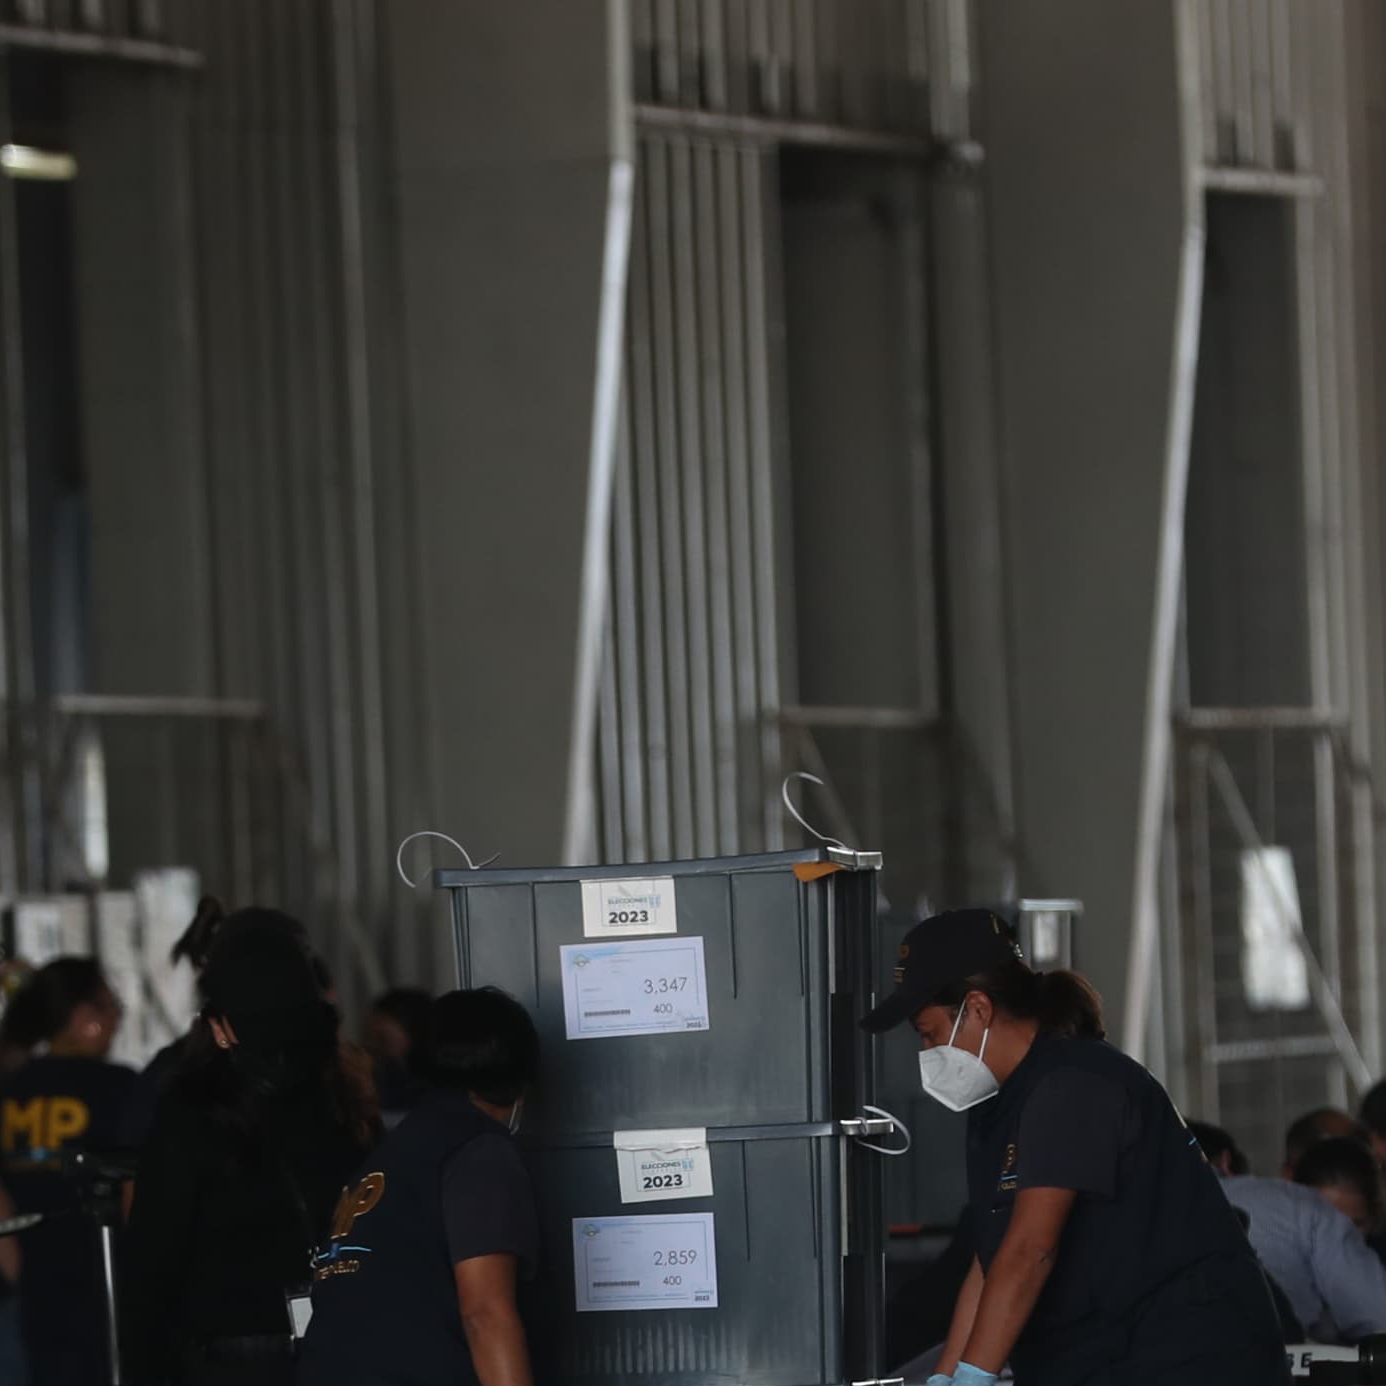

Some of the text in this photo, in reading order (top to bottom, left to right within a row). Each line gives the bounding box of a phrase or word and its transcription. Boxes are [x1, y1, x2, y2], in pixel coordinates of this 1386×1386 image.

[608, 910, 649, 924] 2023
[644, 977, 688, 995] 3,347
[653, 1003, 673, 1014] 400
[2, 1096, 90, 1151] MP
[641, 1161, 681, 1170] ELECCIONES
[643, 1174, 683, 1189] 2023
[654, 1250, 698, 1266] 2,859
[663, 1276, 682, 1286] 400
